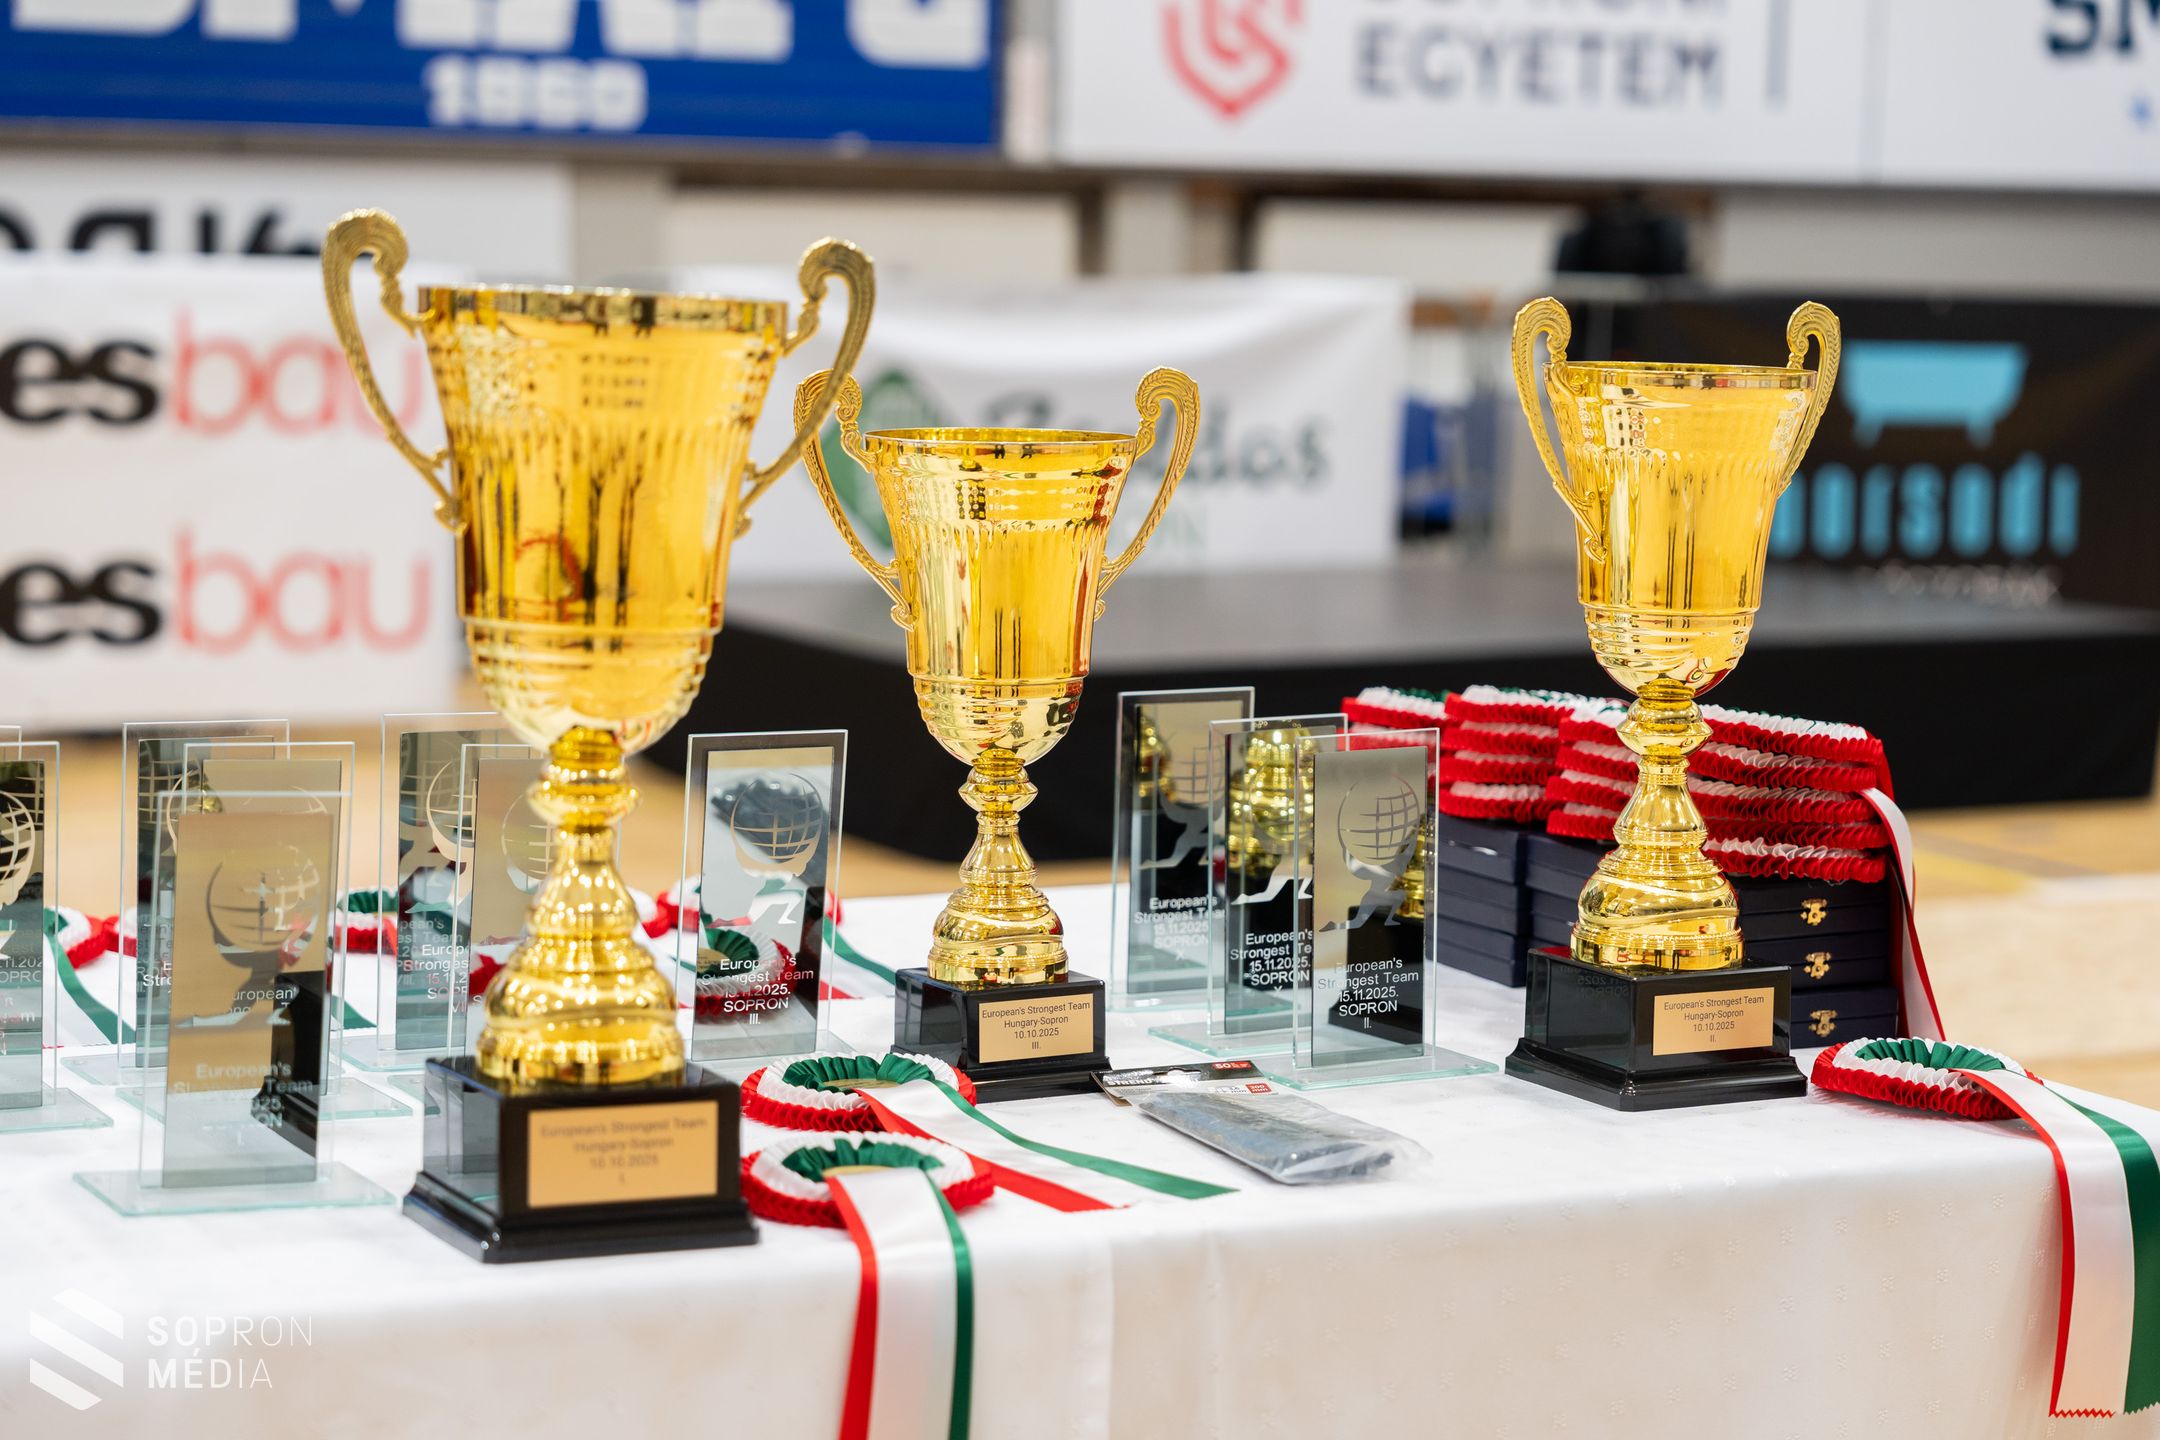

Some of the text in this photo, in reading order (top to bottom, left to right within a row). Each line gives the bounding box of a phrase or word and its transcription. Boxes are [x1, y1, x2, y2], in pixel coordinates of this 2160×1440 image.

[1357, 22, 1723, 108] EGYETEM
[1245, 928, 1313, 945] European's
[1230, 943, 1312, 960] Strongest Te
[403, 959, 469, 972] Stronges
[720, 955, 797, 971] Europ's
[702, 971, 769, 985] Sngest
[1251, 970, 1310, 986] SOPRON
[1384, 971, 1419, 983] Team
[1338, 986, 1399, 1003] 15.11.2025.
[723, 997, 789, 1013] SOPRON
[982, 1001, 1090, 1019] European's Strongest Team
[1339, 1000, 1398, 1017] SOPRON
[1664, 995, 1764, 1011] European's Strongest Team
[749, 1013, 761, 1025] III.
[1004, 1016, 1069, 1029] Hungary-Sopron
[1363, 1016, 1372, 1029] II.
[1684, 1009, 1744, 1021] Hungary-Sopron
[1014, 1028, 1060, 1039] 10.10.2025
[1694, 1021, 1735, 1032] 10.10.2025
